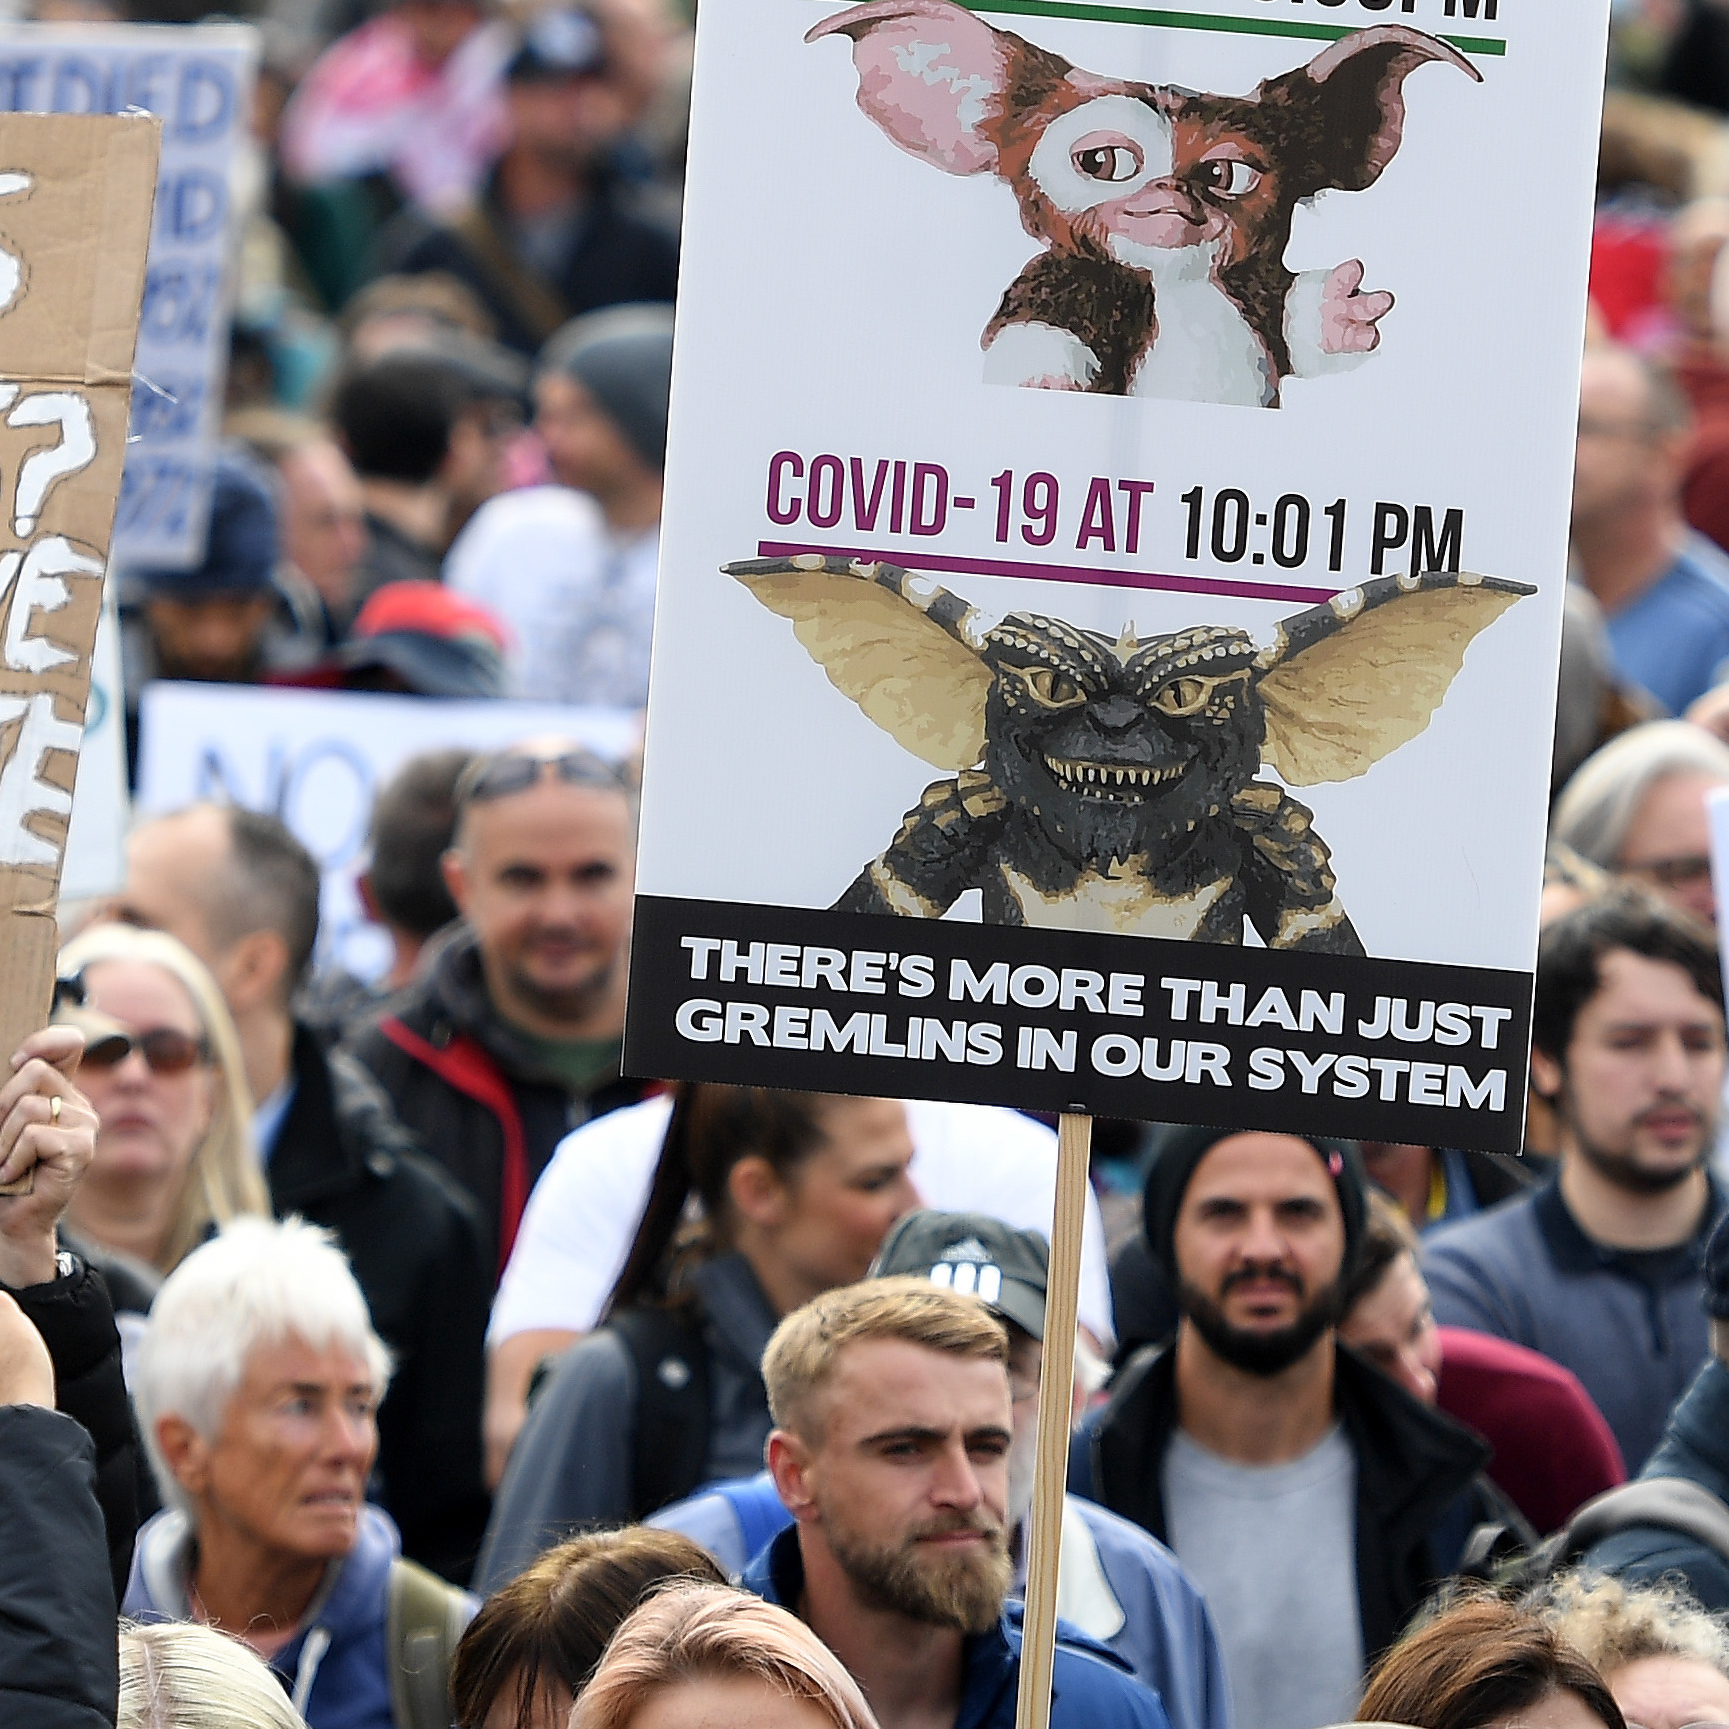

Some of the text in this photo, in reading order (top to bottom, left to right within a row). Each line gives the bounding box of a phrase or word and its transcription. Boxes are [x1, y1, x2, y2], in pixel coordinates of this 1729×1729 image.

[766, 450, 1463, 579] COVID-19 AT 10:01 PM
[680, 935, 1512, 1049] THERE'S MORE THAN JUST
[675, 998, 1507, 1112] GREMLINS IN OUR SYSTEM
